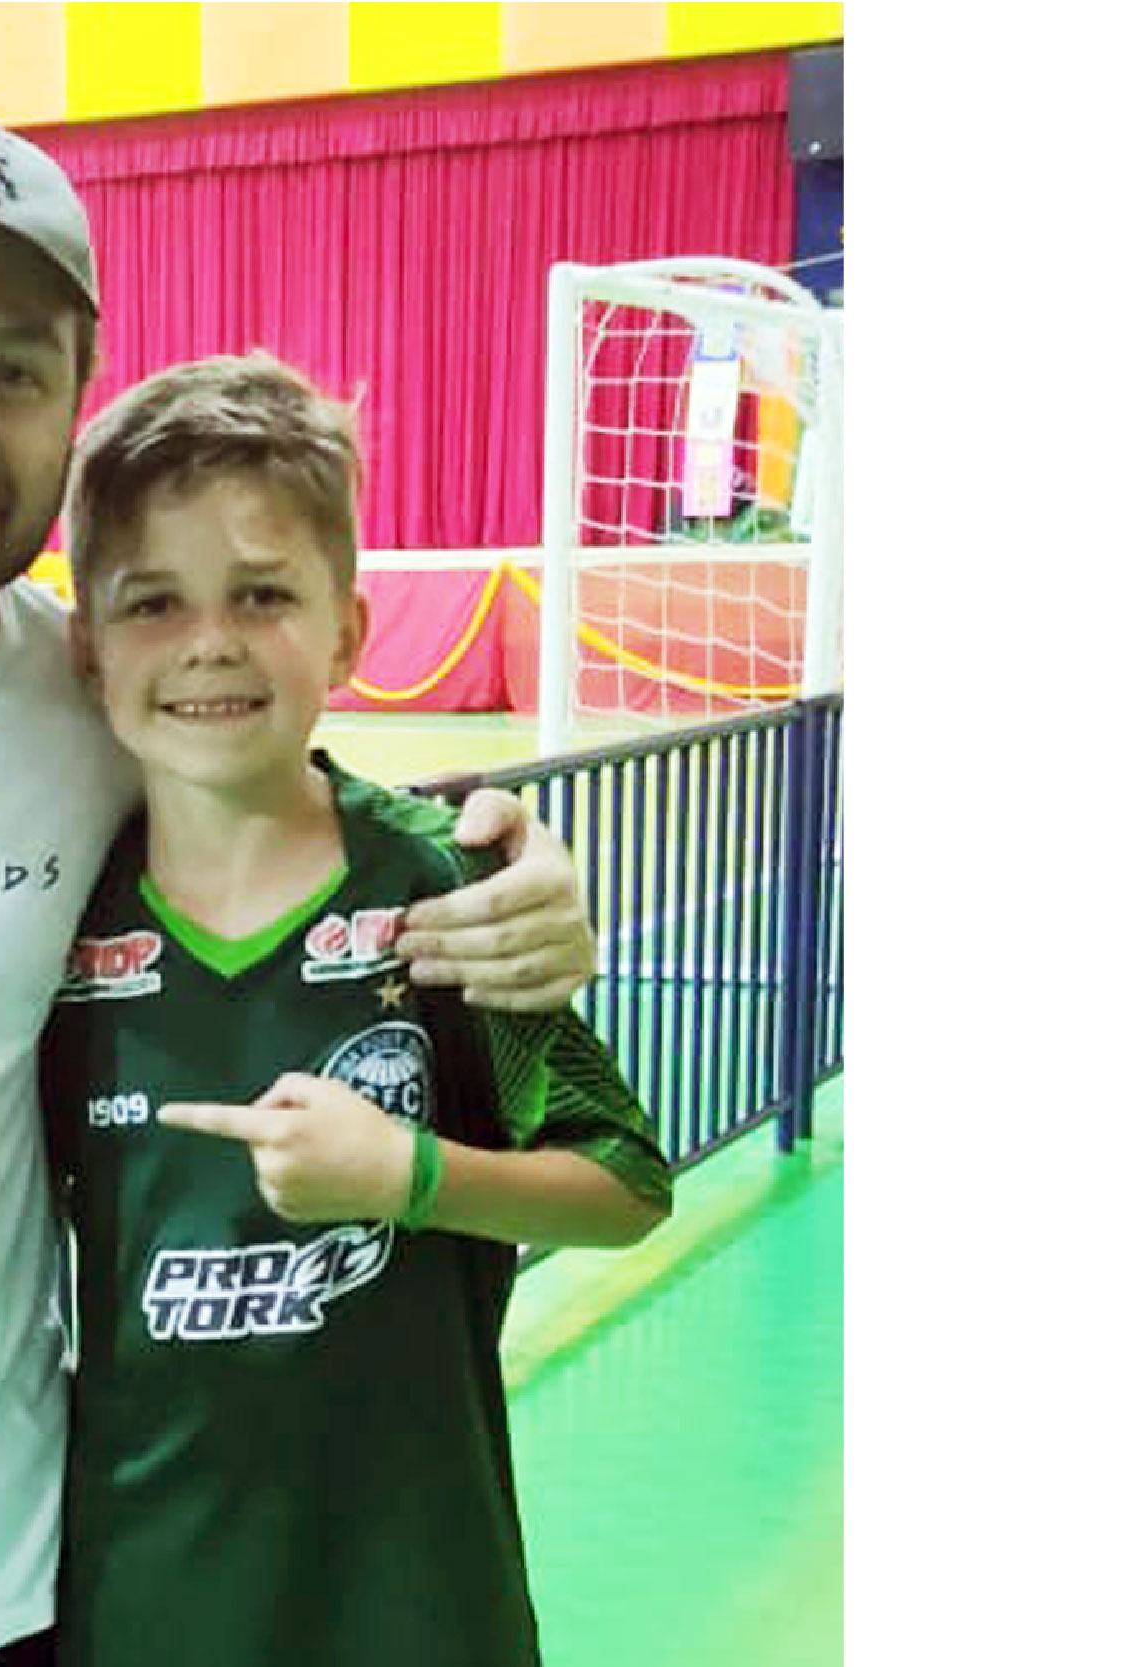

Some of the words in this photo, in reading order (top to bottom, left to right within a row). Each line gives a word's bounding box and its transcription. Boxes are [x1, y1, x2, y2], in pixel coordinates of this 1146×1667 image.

[87, 1091, 149, 1127] 1909
[152, 1247, 294, 1293] PRO
[147, 1290, 319, 1336] TORK
